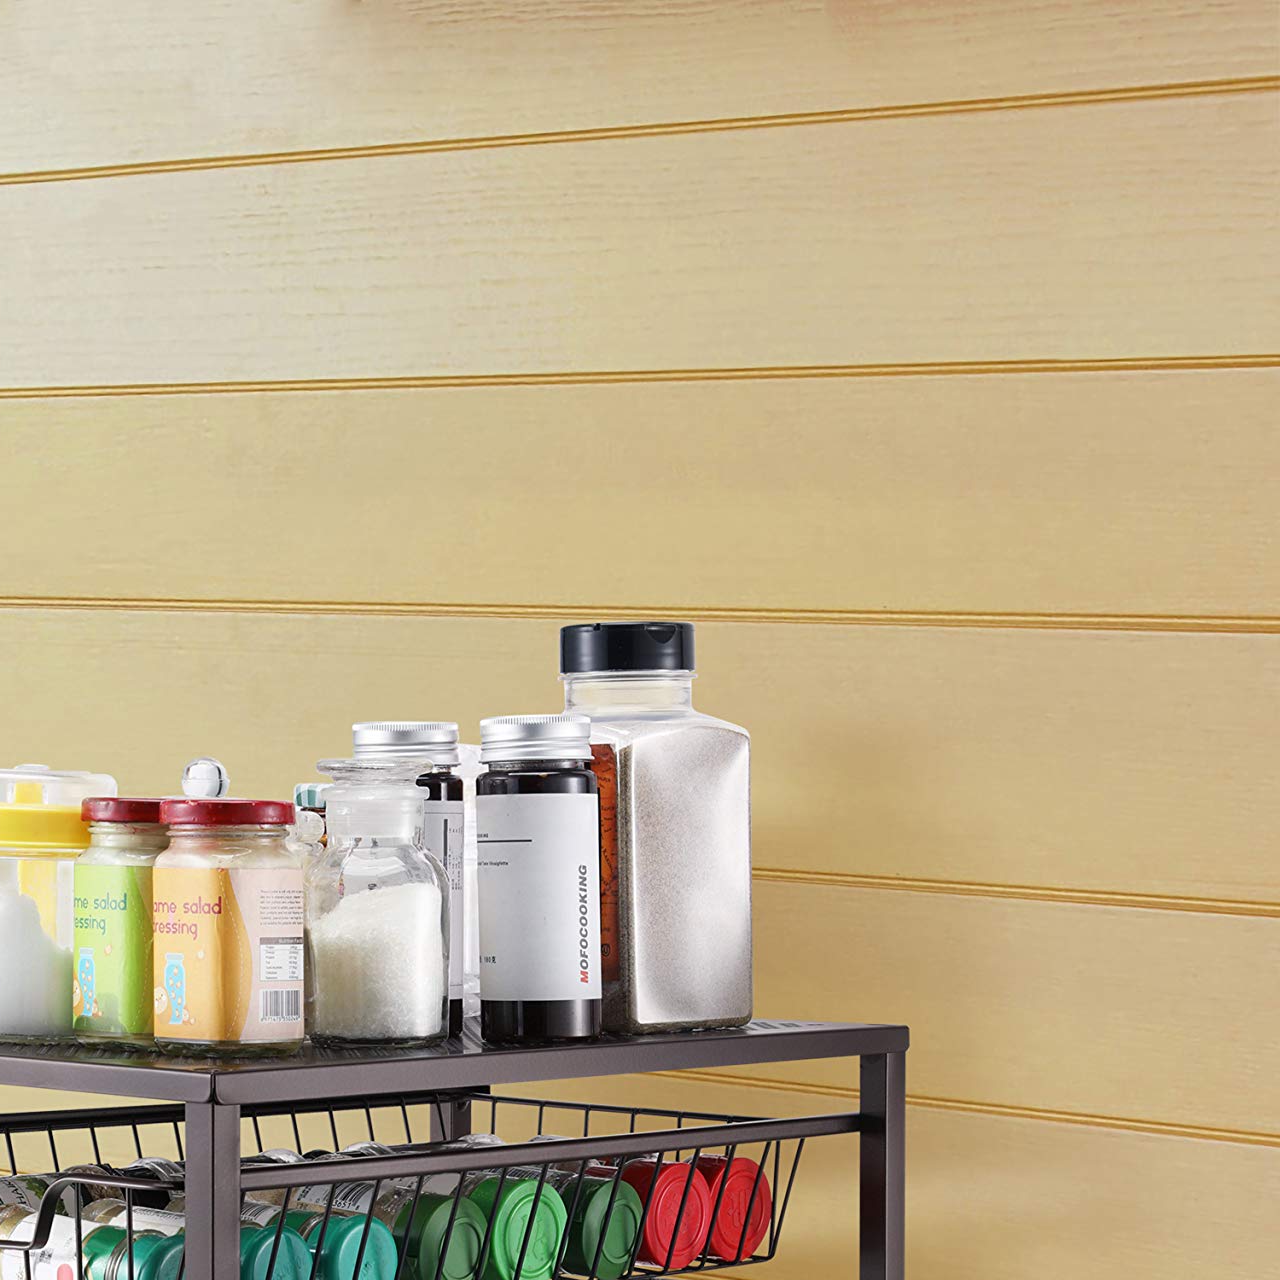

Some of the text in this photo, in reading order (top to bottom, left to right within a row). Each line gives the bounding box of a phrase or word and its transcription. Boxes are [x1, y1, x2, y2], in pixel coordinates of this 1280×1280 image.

[94, 892, 127, 911] salad
[183, 896, 223, 915] salad
[578, 865, 589, 983] MOFOCOOKING
